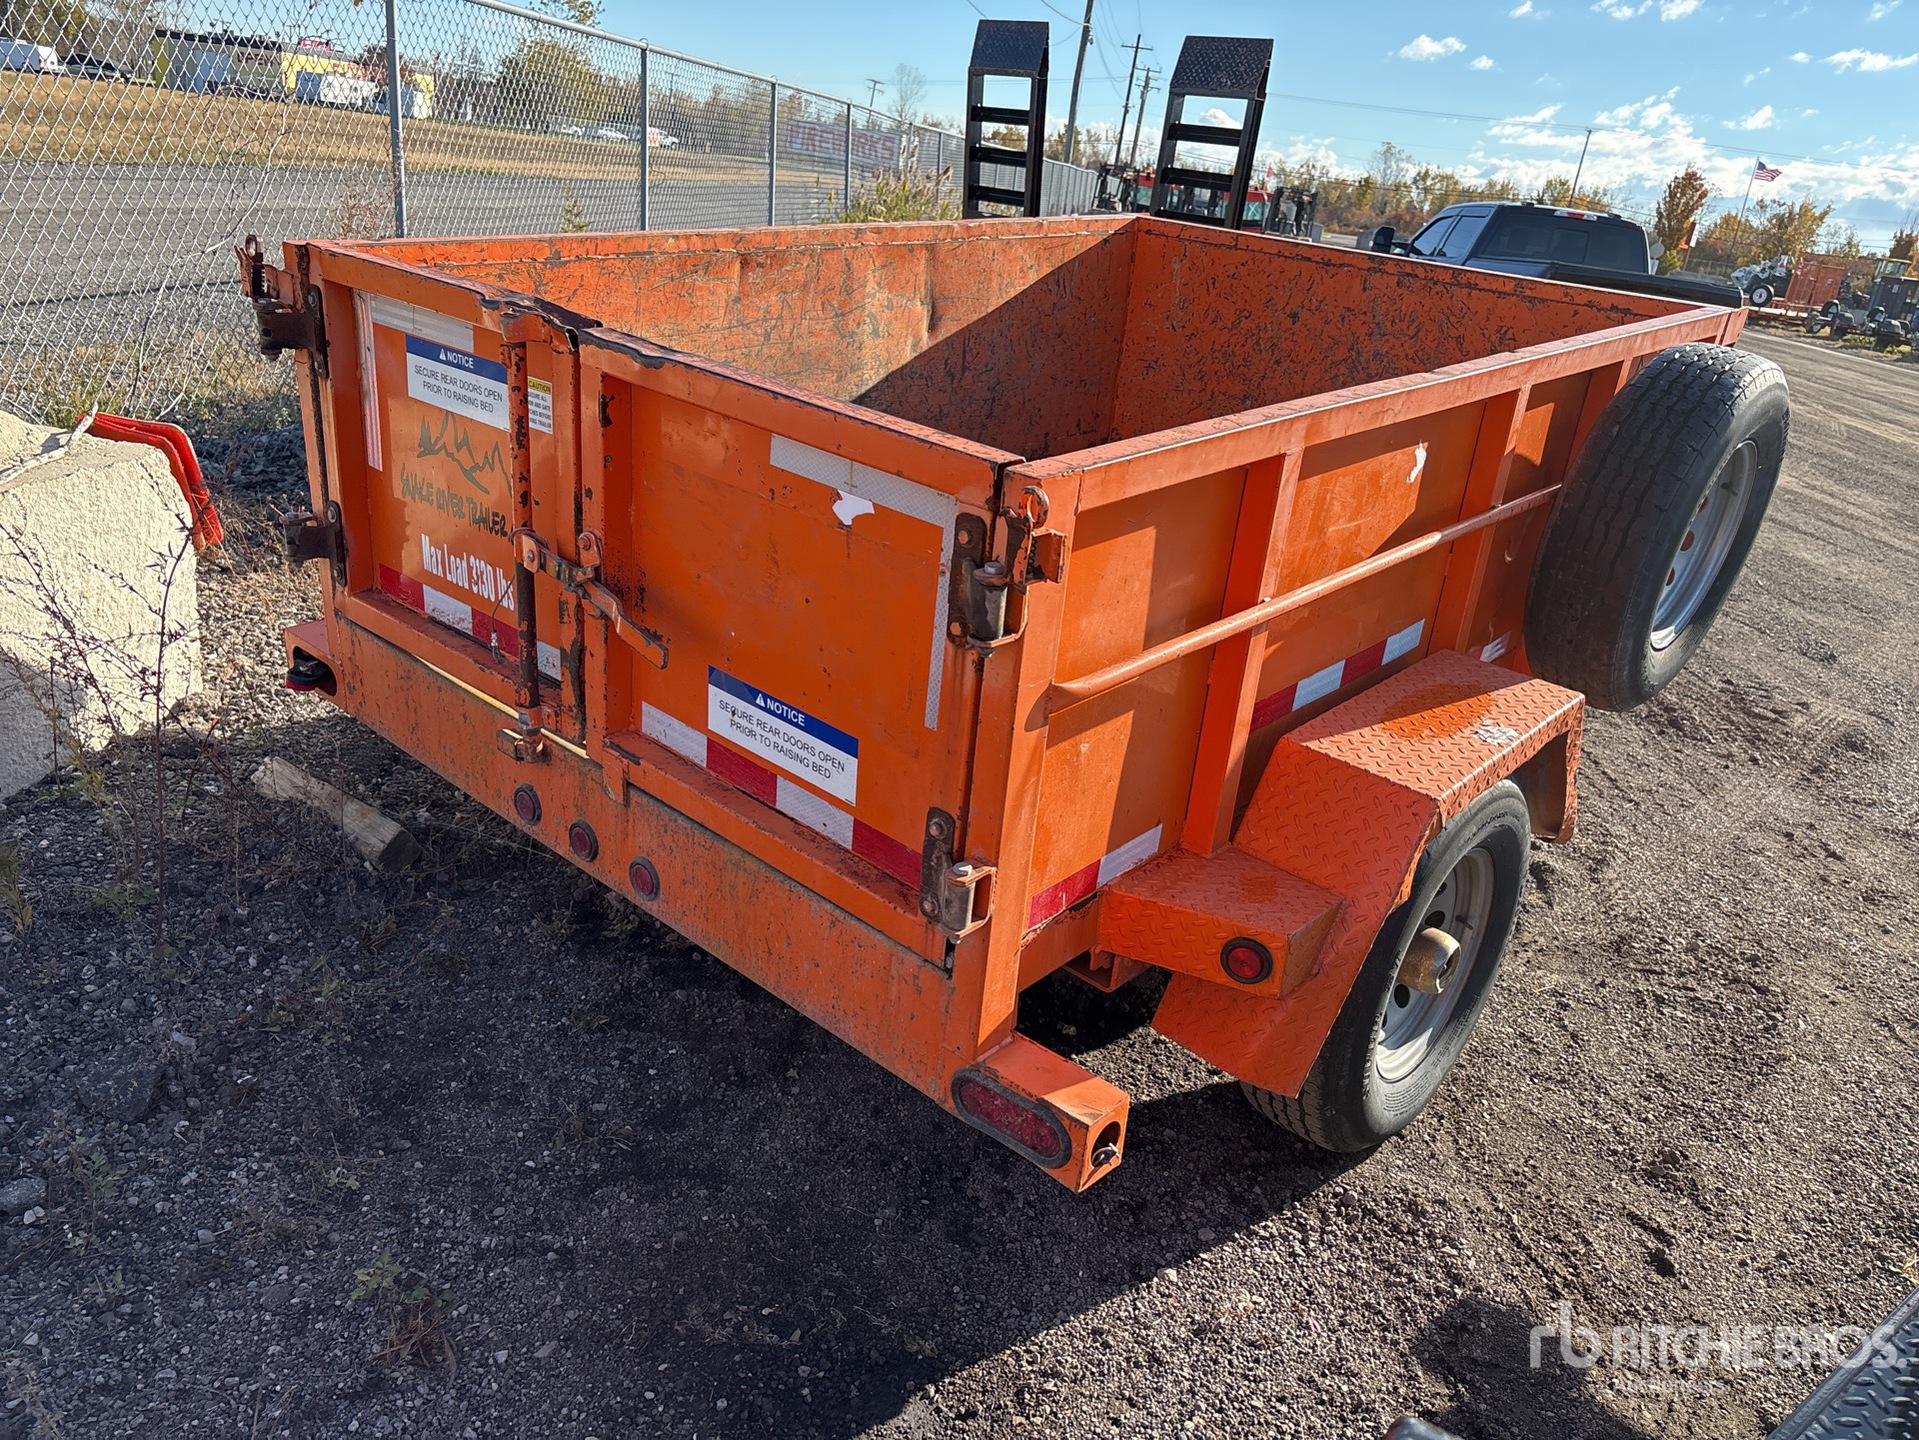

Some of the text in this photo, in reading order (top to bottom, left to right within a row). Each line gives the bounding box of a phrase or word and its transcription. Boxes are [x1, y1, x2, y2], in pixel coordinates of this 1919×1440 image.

[447, 351, 474, 369] NOTICE
[414, 364, 503, 402] SECURE REAR DOORS OPEN
[423, 380, 494, 413] PRIOR TO RAISING BED
[529, 380, 551, 392] CAUTION
[421, 533, 515, 611] Max Load 3130 lbs
[766, 698, 806, 727] NOTICE
[719, 699, 846, 773] SECURE REAR DOORS OPEN
[729, 718, 832, 780] PRIOR TO RAISING BED
